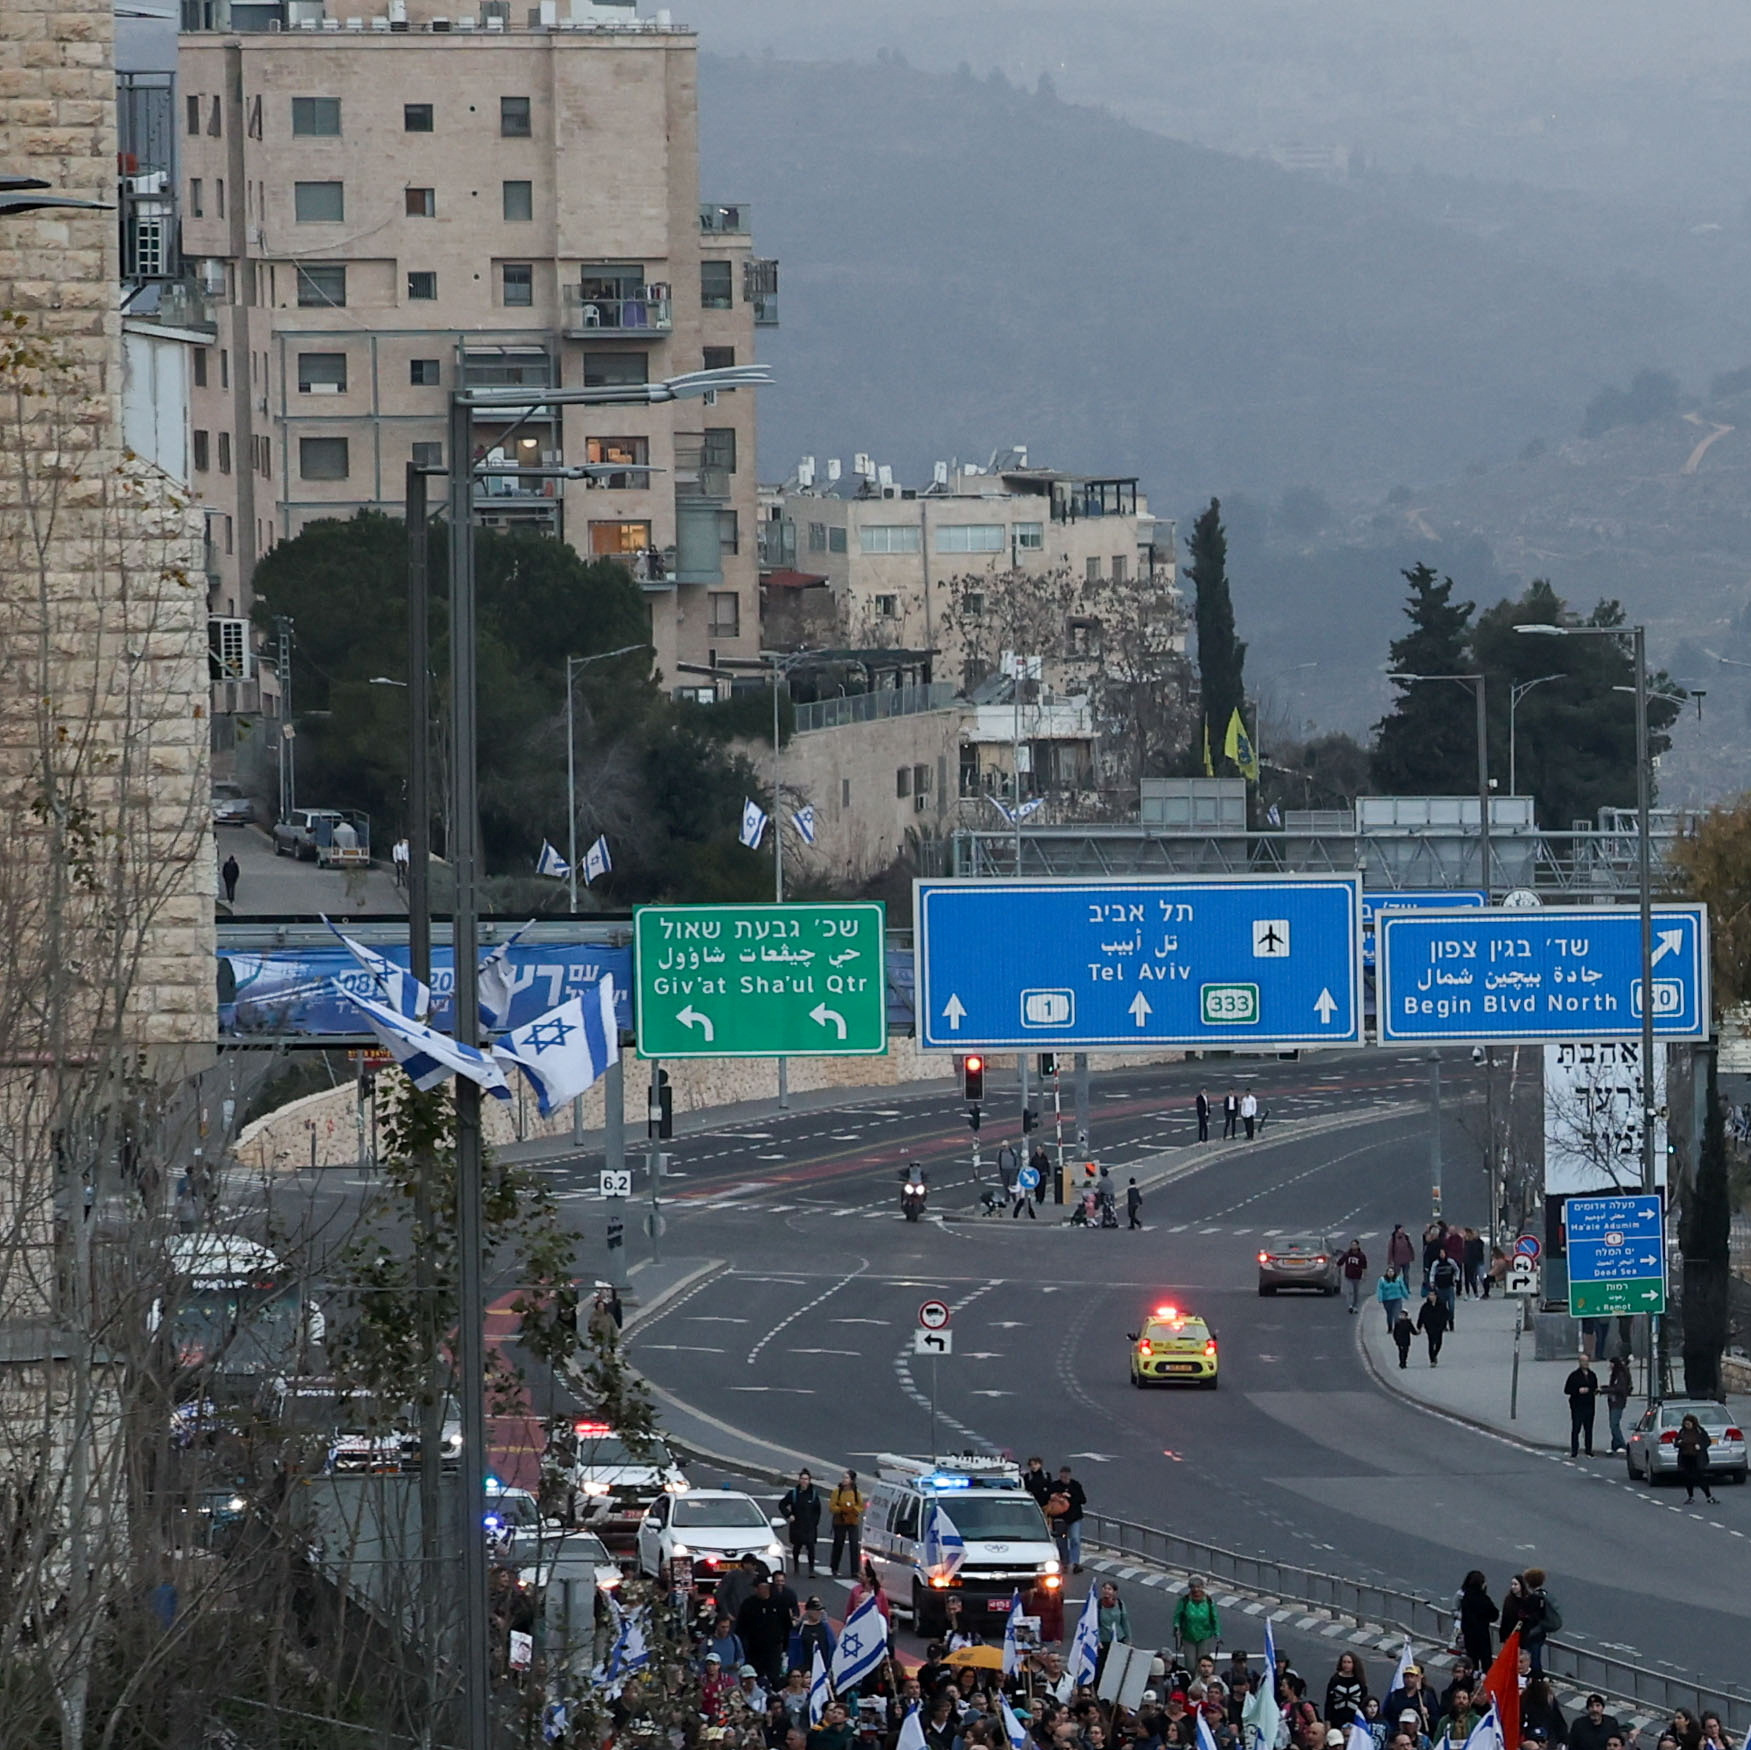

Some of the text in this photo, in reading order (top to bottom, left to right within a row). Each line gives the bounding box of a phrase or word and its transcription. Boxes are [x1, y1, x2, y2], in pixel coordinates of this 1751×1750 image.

[1088, 900, 1194, 923] תל אביב
[660, 917, 721, 939] שאול
[734, 920, 800, 941] גבעת
[1430, 940, 1477, 963] צפון
[1490, 939, 1532, 962] בגין
[568, 965, 600, 982] עם
[1088, 963, 1191, 981] Tel Aviv
[654, 974, 867, 995] Giv'at Sha'ul Qtr
[1044, 995, 1249, 1017] 1 333
[1404, 993, 1617, 1018] Begin Blvd North
[603, 1176, 628, 1191] 6.2
